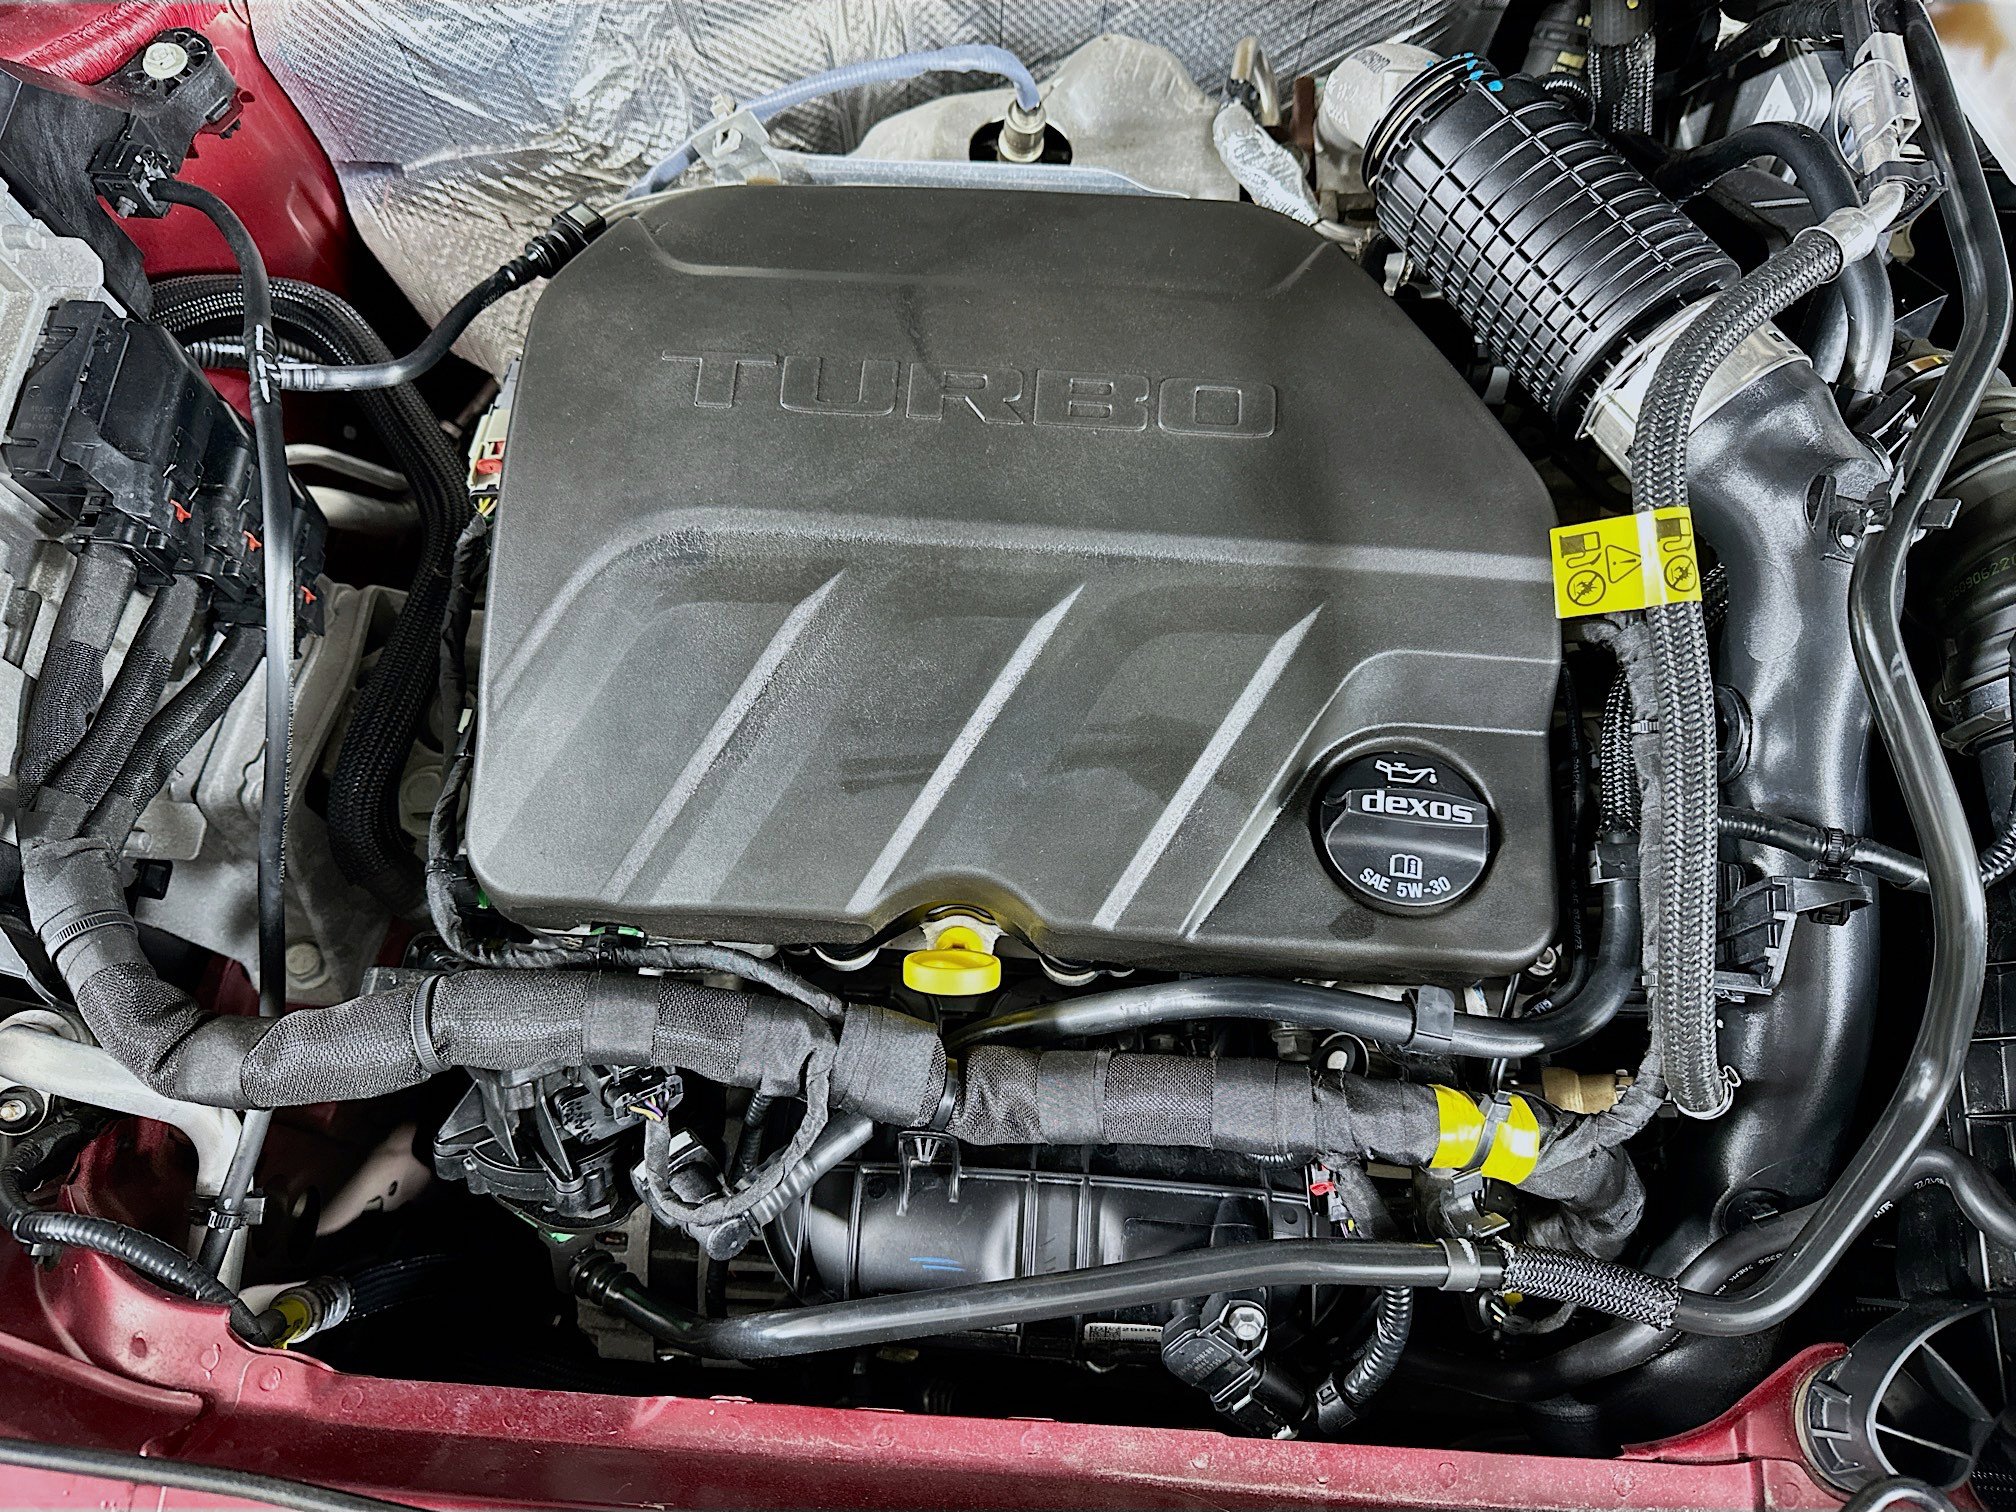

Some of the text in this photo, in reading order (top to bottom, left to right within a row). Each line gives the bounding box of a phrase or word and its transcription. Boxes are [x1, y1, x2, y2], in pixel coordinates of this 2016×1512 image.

[661, 349, 1278, 438] TURBO
[1361, 789, 1477, 824] dexos
[1359, 867, 1451, 898] SAE 5W-30
